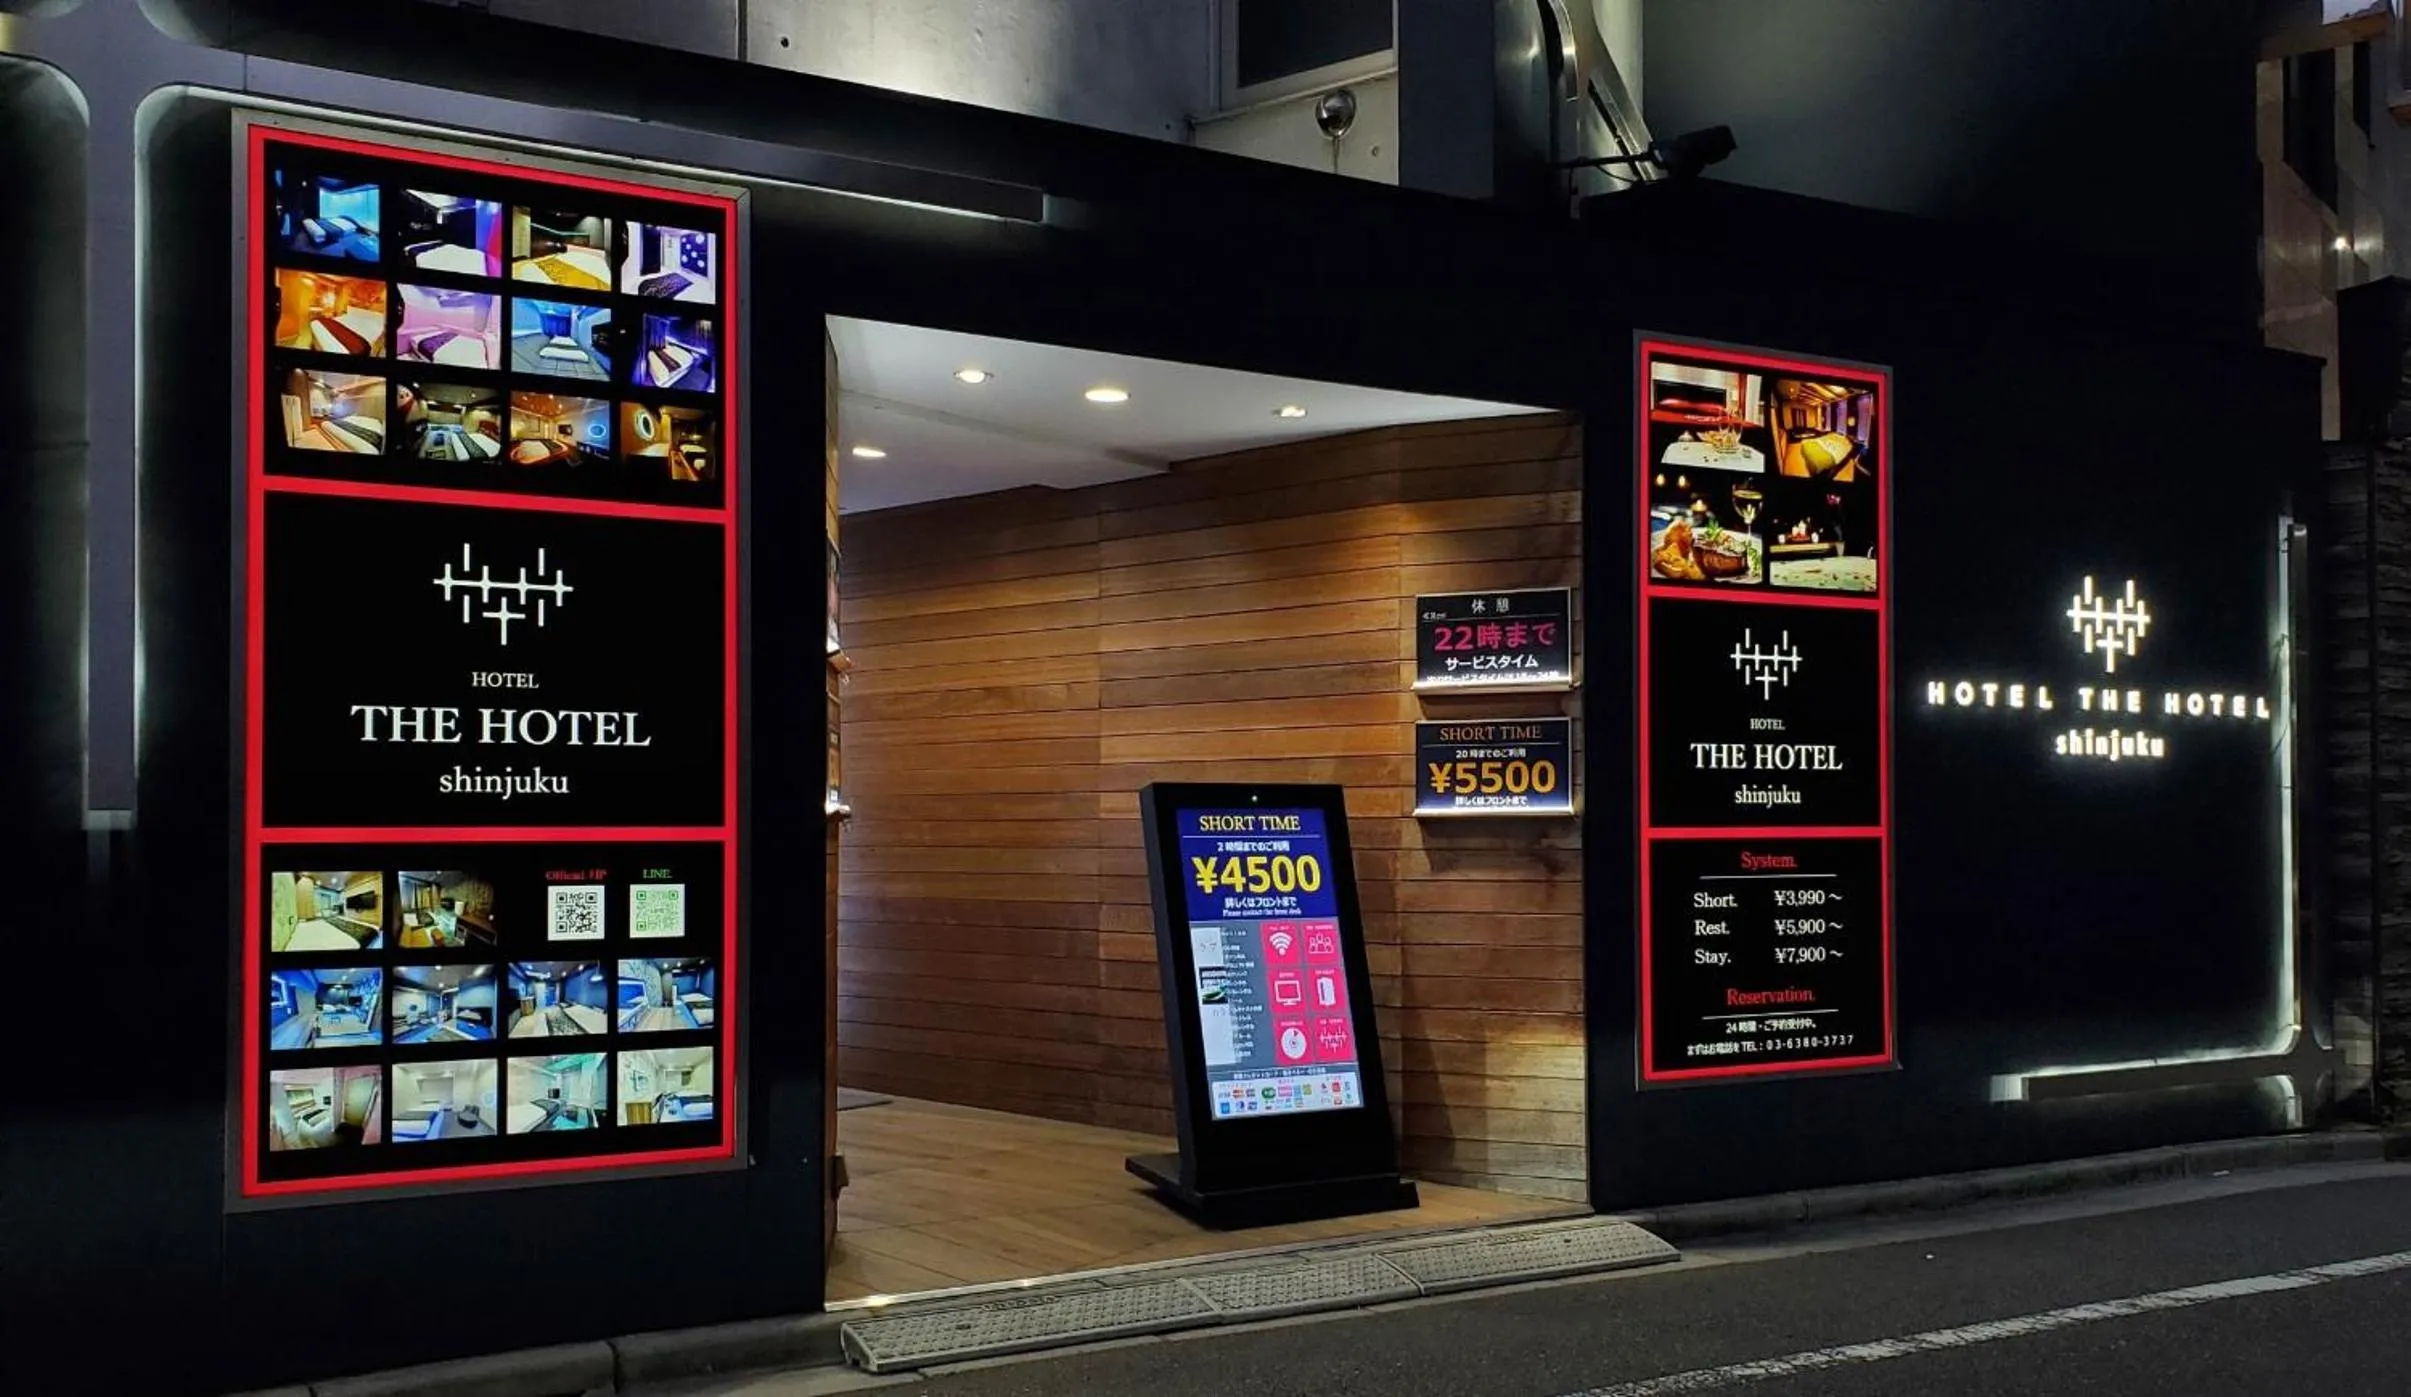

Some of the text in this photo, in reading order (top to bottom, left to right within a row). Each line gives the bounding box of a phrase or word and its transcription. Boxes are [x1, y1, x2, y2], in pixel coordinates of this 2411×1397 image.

[1471, 596, 1510, 614] 休憩
[1434, 622, 1556, 651] 22時まで
[1445, 654, 1539, 671] サービスタイム
[473, 672, 538, 688] HOTEL
[1928, 681, 2271, 720] HOTEL THE HOTEL
[351, 706, 651, 746] THE HOTEL
[1439, 725, 1543, 742] SHORT TIME
[1751, 719, 1784, 729] HOTEL
[2055, 728, 2165, 762] shinjuku
[1691, 744, 1842, 769] THE HOTEL
[440, 766, 568, 799] shinjuku
[1428, 759, 1556, 794] ¥5500
[1736, 784, 1800, 808] shinjuku
[1200, 815, 1301, 831] SHORT TIME
[1741, 851, 1797, 870] System.
[1192, 855, 1321, 894] ¥4500
[1694, 892, 1737, 907] Short.
[1695, 920, 1729, 935] Rest.
[1695, 949, 1731, 965] Stay.
[1727, 986, 1815, 1005] Reservation.
